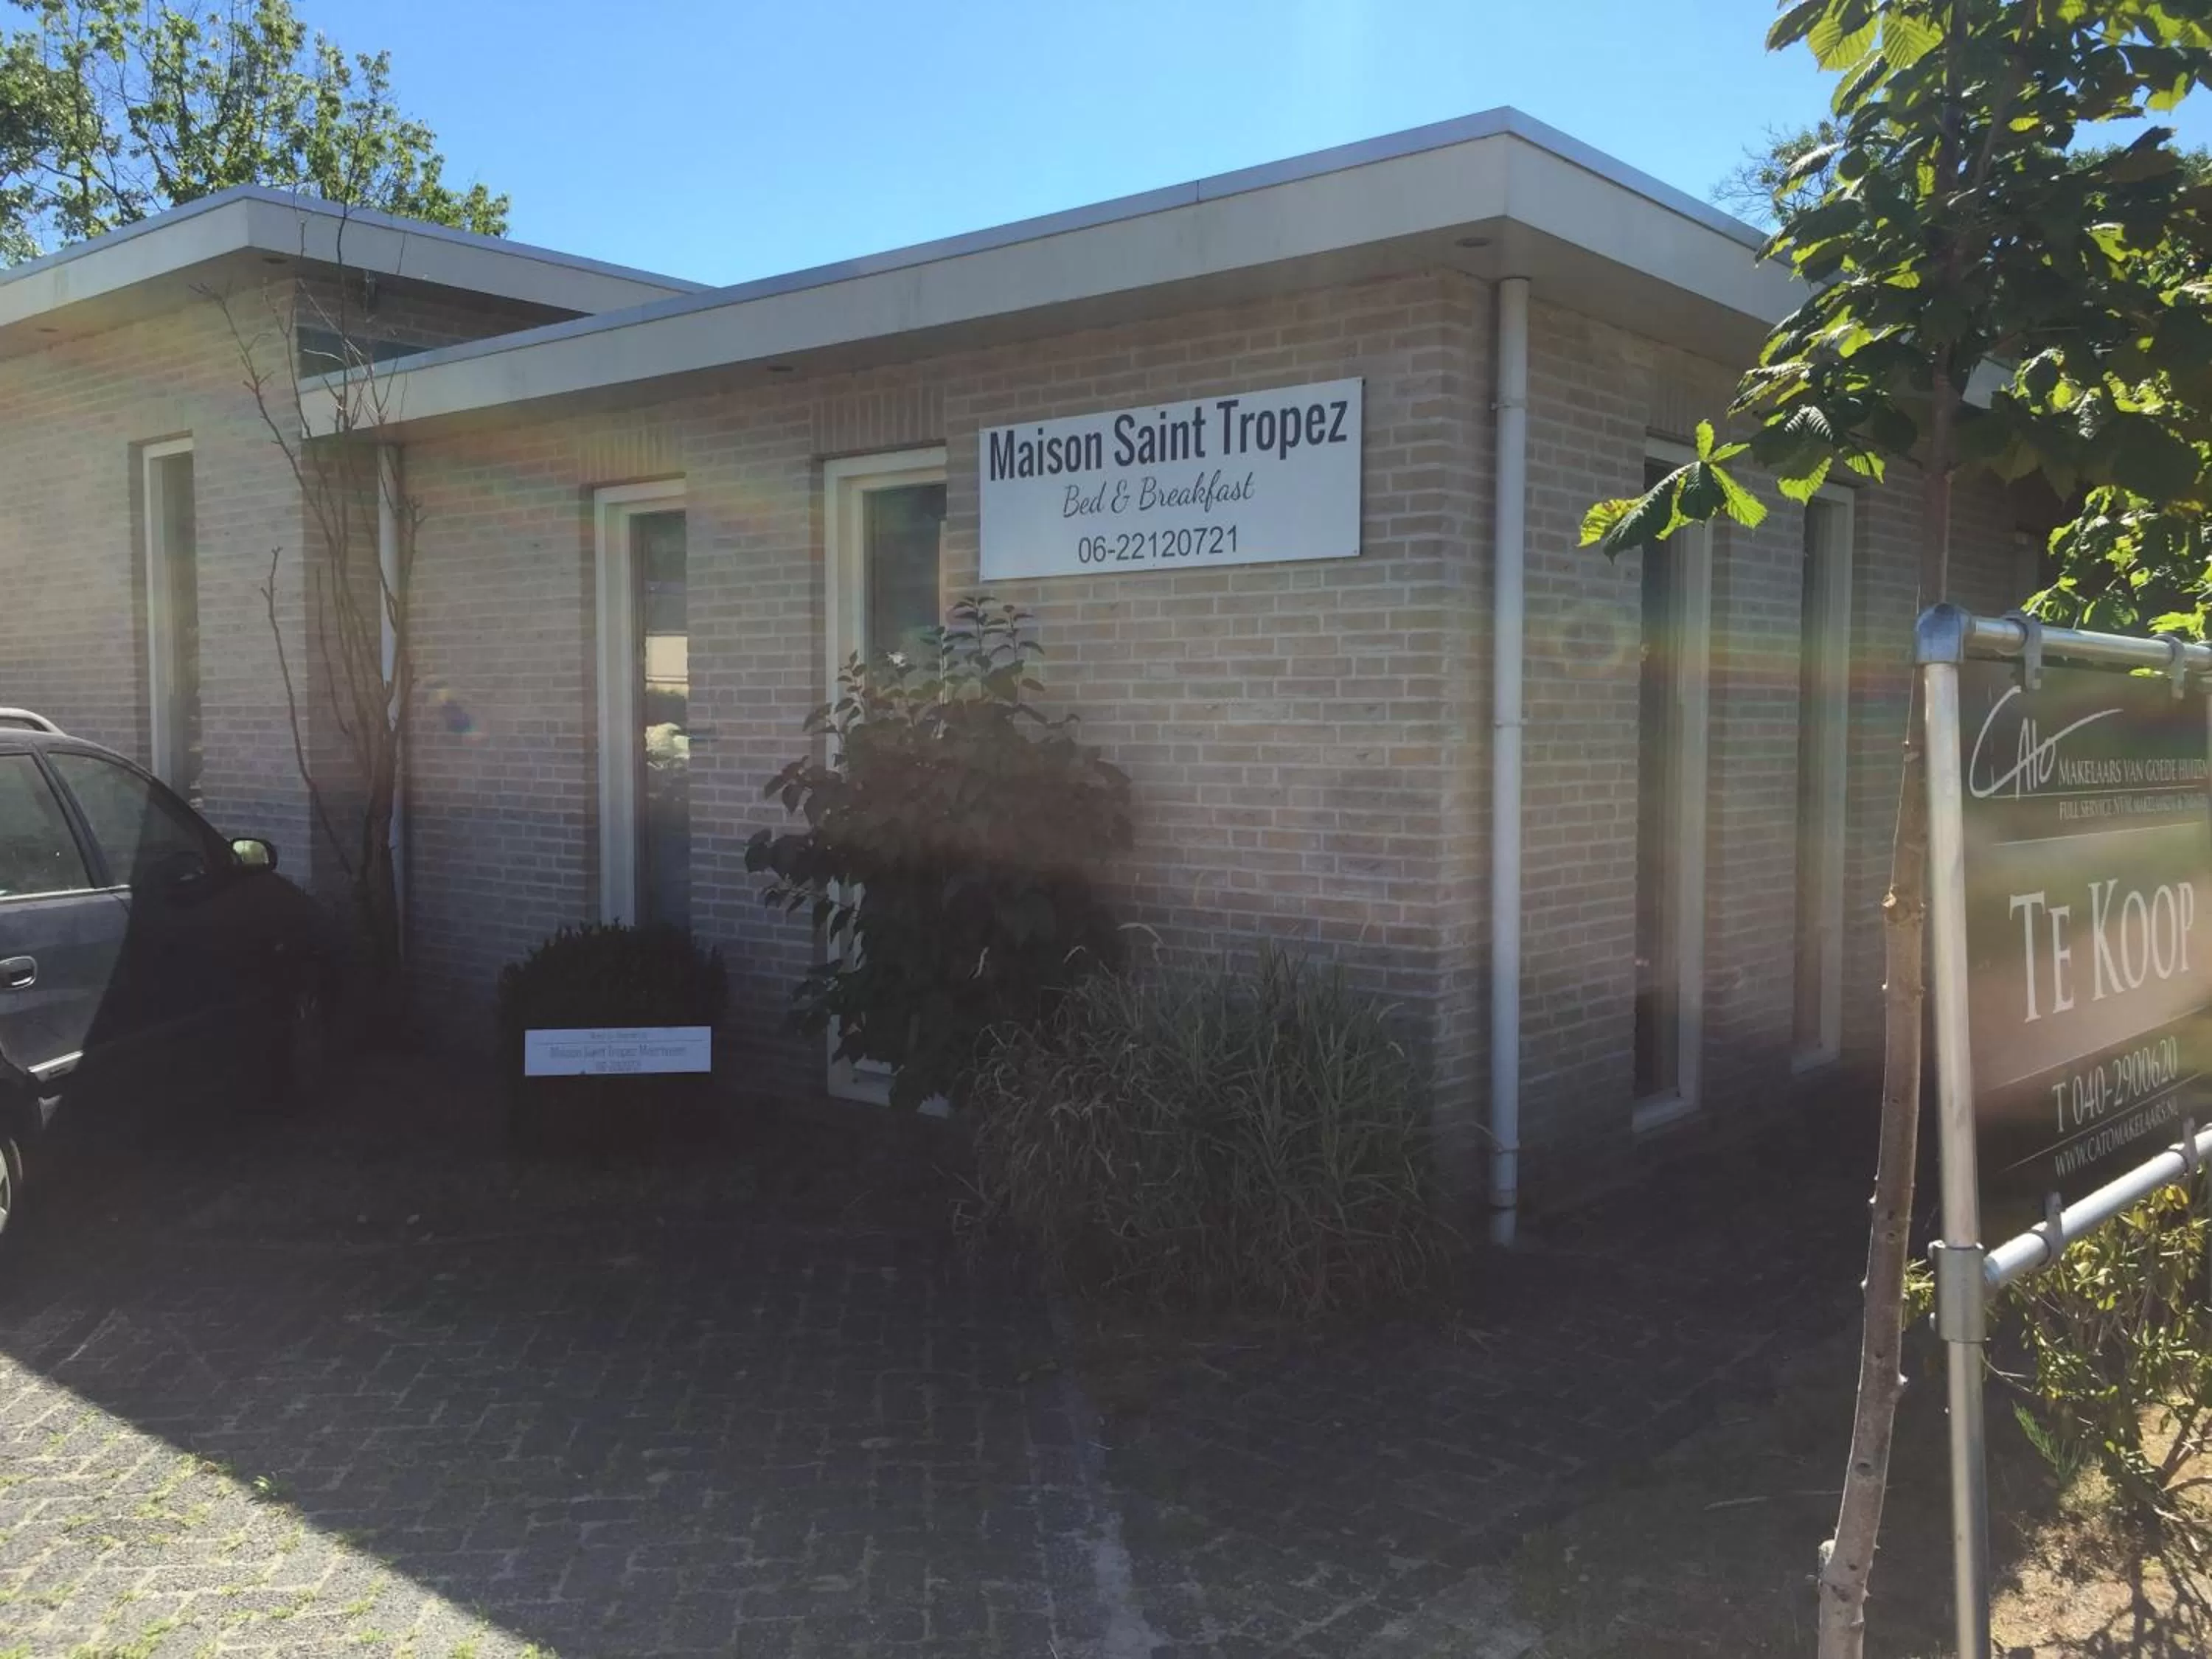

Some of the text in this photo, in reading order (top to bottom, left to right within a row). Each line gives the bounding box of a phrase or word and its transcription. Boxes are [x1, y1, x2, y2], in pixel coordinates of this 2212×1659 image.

[990, 400, 1348, 481] Maison Saint Tropez
[1063, 470, 1255, 518] Bed & Breakfast
[1079, 525, 1237, 563] 06-22120721
[2123, 758, 2144, 782] VAN
[2088, 878, 2195, 1002] KOOP
[2052, 1035, 2177, 1133] T 040-2900620
